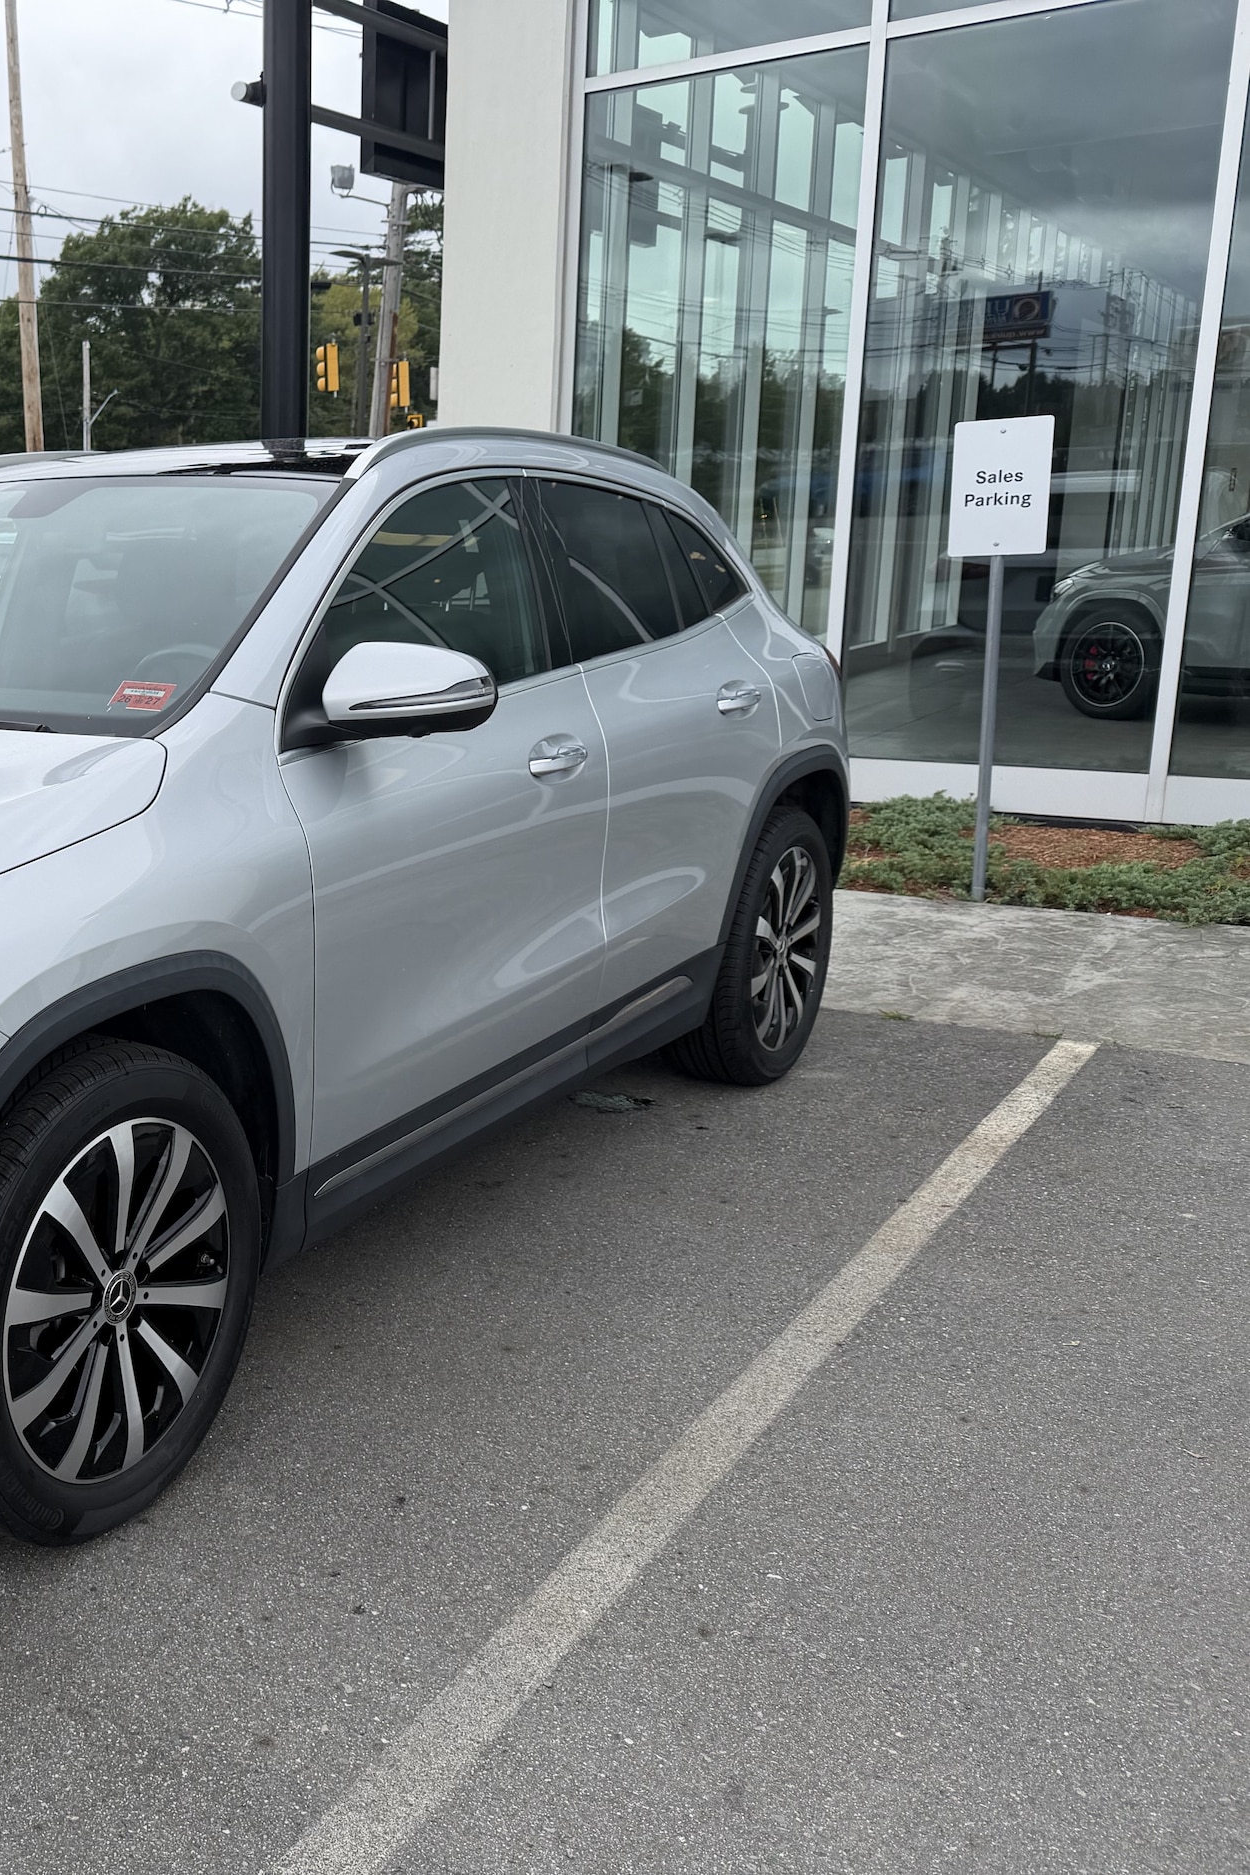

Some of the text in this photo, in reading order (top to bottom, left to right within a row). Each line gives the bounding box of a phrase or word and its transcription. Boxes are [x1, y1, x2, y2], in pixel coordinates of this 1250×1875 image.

[975, 469, 1024, 485] Sales
[964, 491, 1032, 508] Parking
[144, 695, 162, 706] 27
